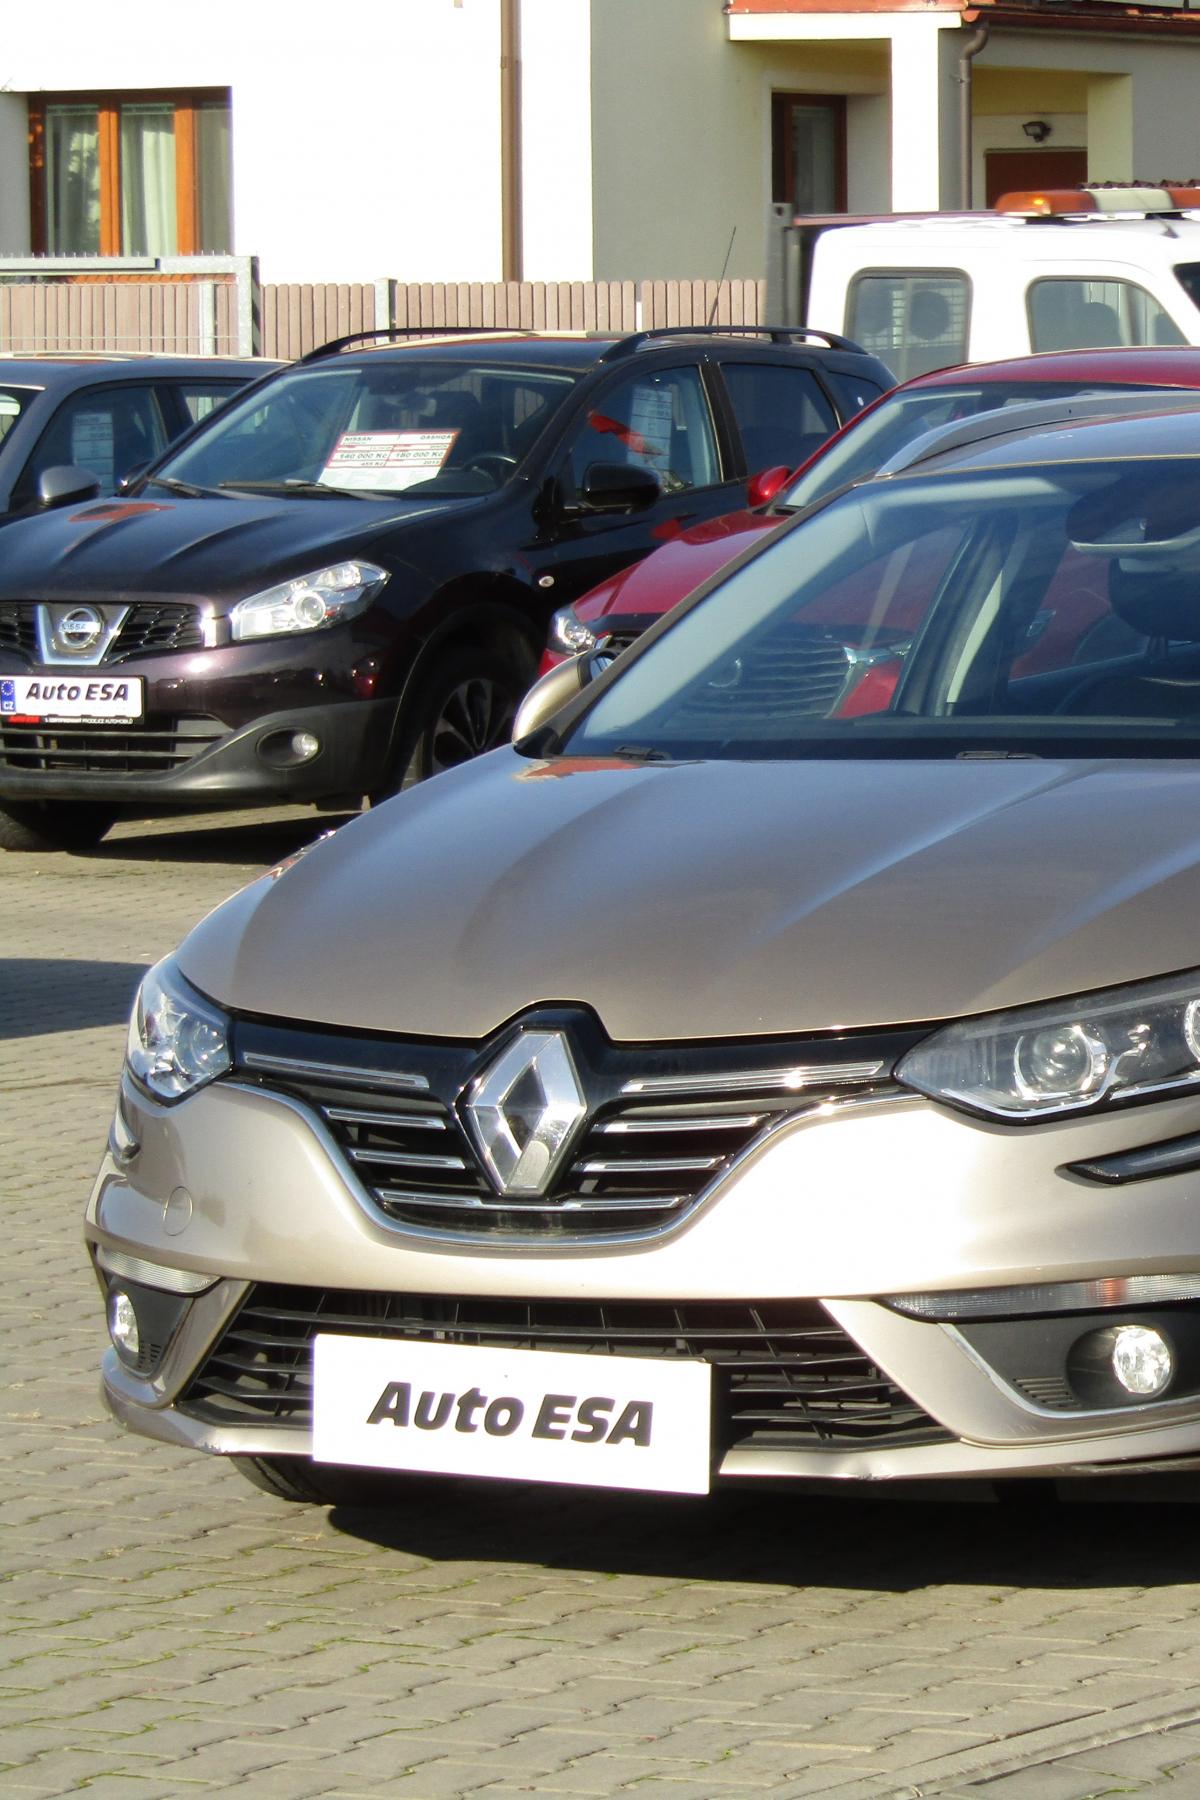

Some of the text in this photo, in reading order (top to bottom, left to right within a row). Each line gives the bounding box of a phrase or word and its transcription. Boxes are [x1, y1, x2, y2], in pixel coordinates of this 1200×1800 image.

[26, 682, 129, 701] Auto ESA
[3, 701, 14, 710] CZ
[366, 1381, 654, 1447] Auto ESA
